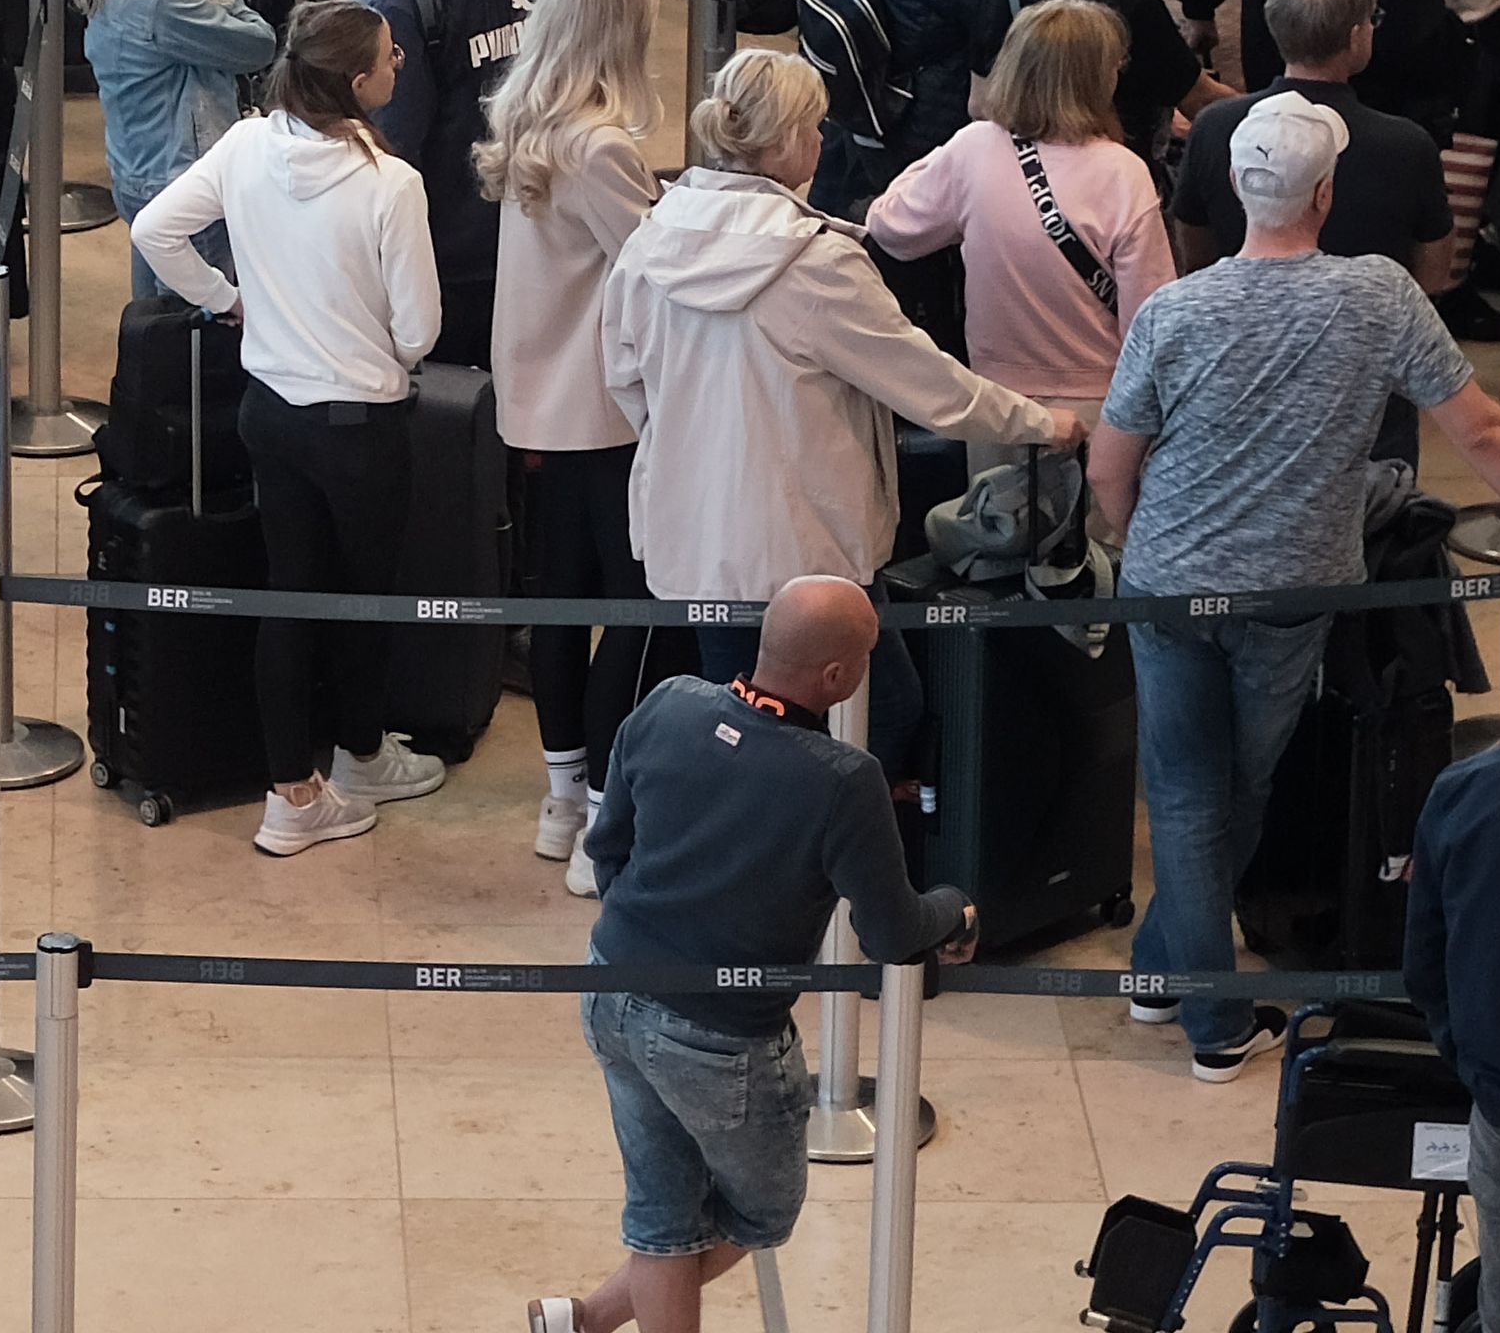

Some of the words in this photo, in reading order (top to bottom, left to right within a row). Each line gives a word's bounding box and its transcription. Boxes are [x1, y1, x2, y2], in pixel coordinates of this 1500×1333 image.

[1451, 578, 1490, 597] BER
[148, 588, 188, 608] BER
[1190, 597, 1229, 615] BER
[418, 600, 458, 619] BER
[688, 604, 728, 622] BER
[926, 606, 966, 623] BER
[416, 967, 461, 987] BER
[717, 968, 760, 986] BER
[1120, 975, 1164, 993] BER
